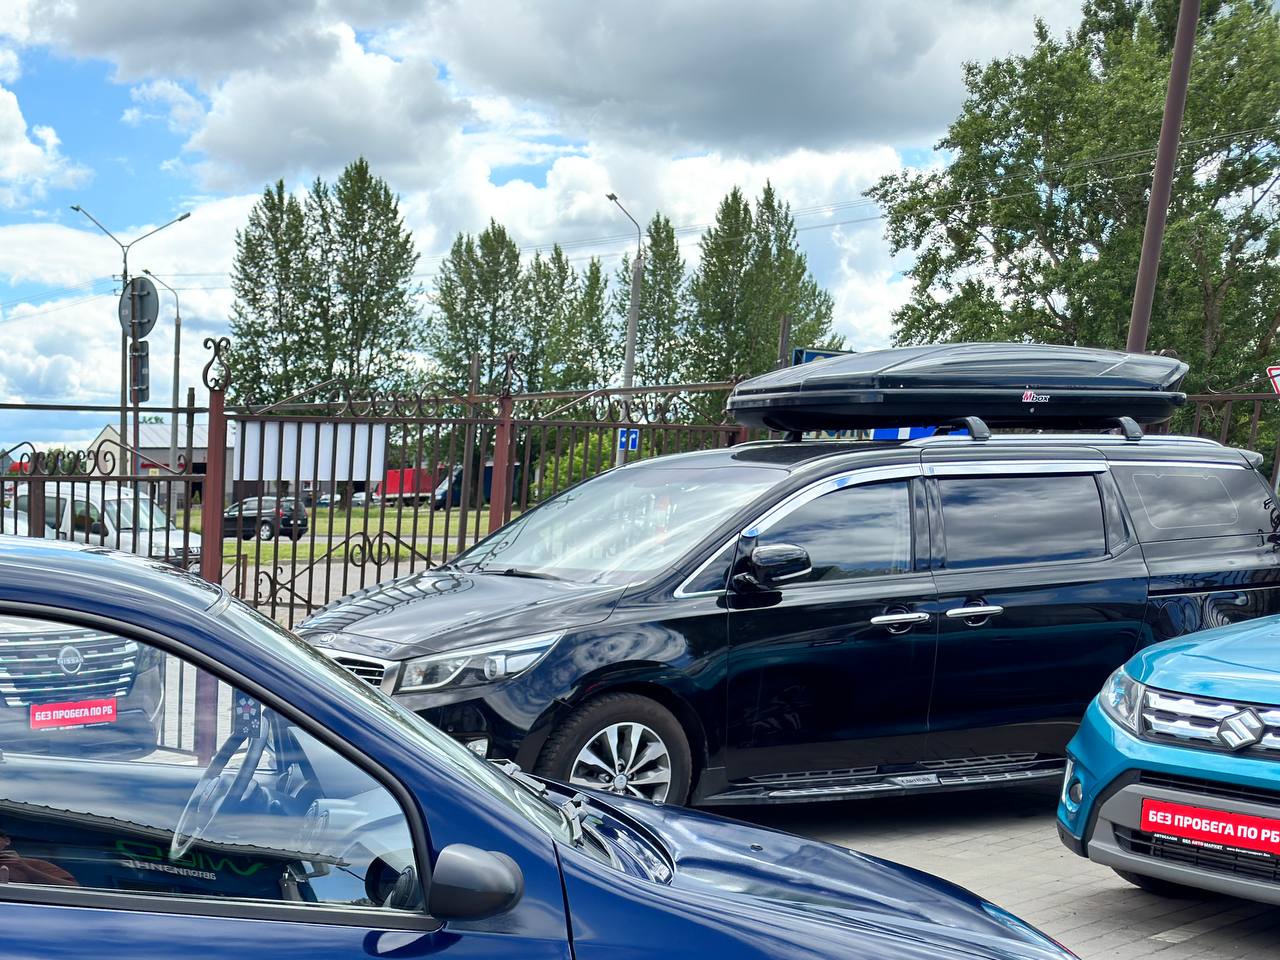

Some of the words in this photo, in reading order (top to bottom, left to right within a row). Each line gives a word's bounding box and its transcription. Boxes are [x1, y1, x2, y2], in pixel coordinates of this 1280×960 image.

[35, 711, 51, 721] БЕЗ
[52, 708, 89, 720] ПРОБЕГА
[90, 706, 102, 716] ПО
[102, 705, 113, 715] РБ
[1148, 810, 1172, 825] БЕЗ
[1174, 814, 1235, 836] ПРОБЕГА
[1237, 825, 1258, 840] ПО
[1261, 829, 1280, 843] РБ
